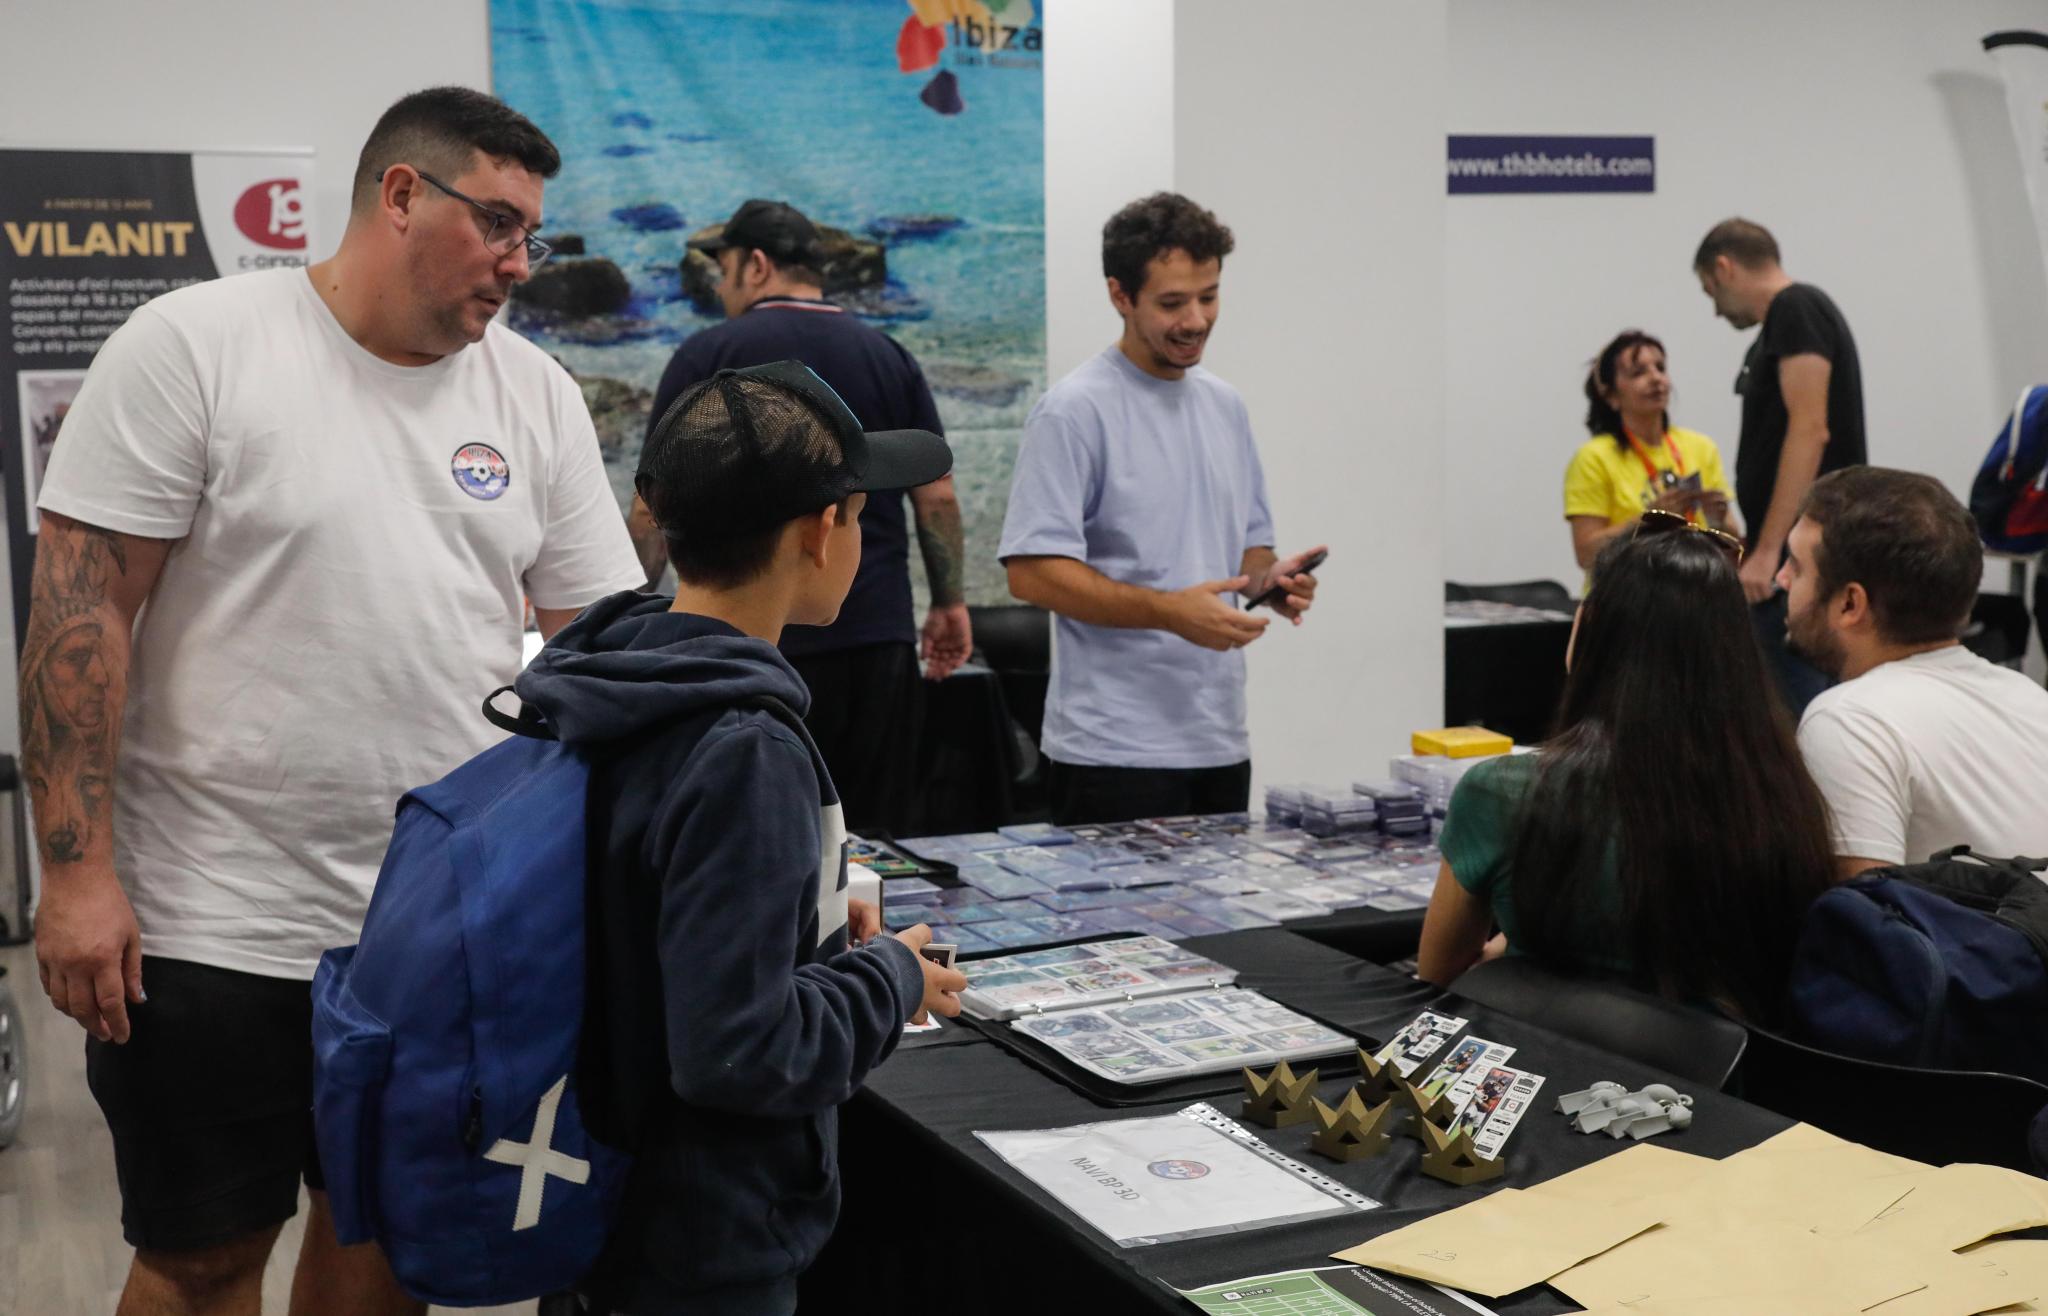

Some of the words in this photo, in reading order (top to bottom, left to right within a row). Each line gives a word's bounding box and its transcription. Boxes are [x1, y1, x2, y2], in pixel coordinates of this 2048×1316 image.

[952, 15, 1042, 50] Ibiza
[1448, 152, 1651, 176] www.thbhotels.com
[3, 221, 194, 257] VILANIT
[1069, 1157, 1109, 1178] NAVI
[1097, 1177, 1124, 1187] BP
[1113, 1188, 1140, 1200] 3D
